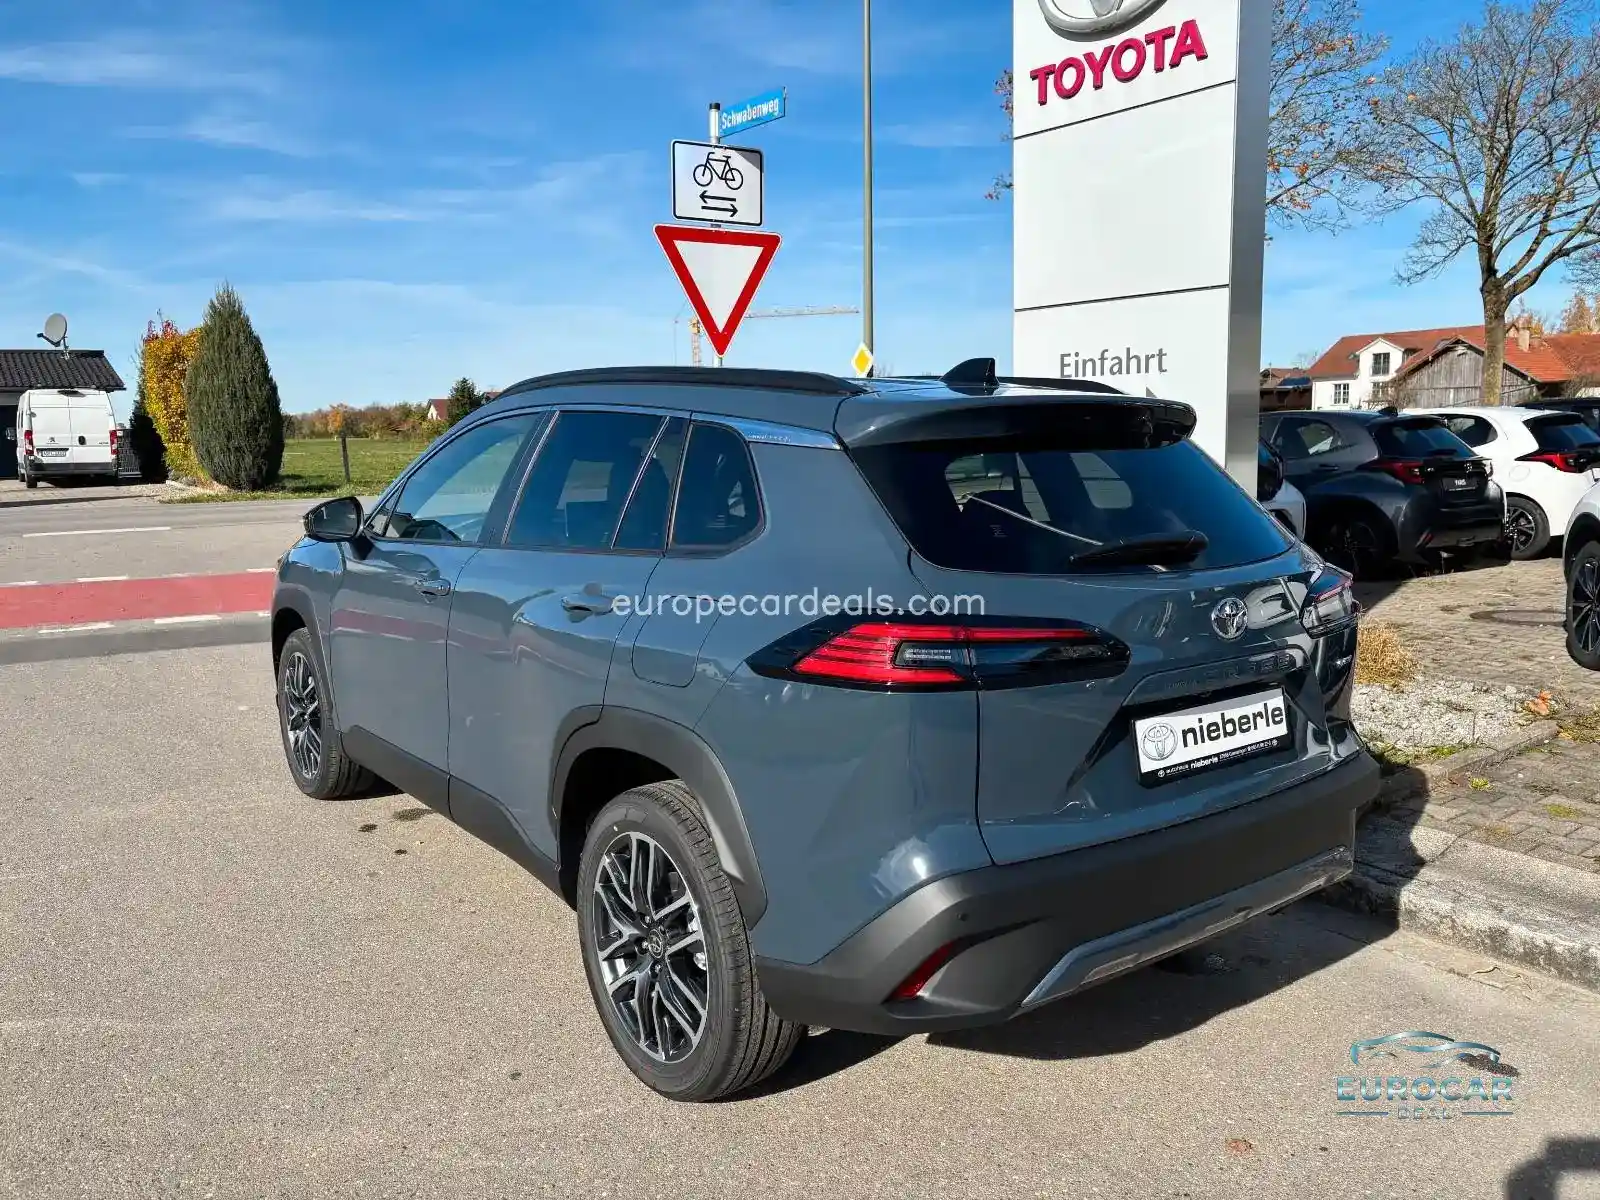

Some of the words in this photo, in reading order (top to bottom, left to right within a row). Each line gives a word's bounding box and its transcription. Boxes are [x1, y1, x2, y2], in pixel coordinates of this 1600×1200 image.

[1030, 19, 1208, 106] TOYOTA
[721, 97, 779, 130] Schwabenweg
[1060, 347, 1167, 378] Einfahrt
[1181, 703, 1284, 748] nieberle
